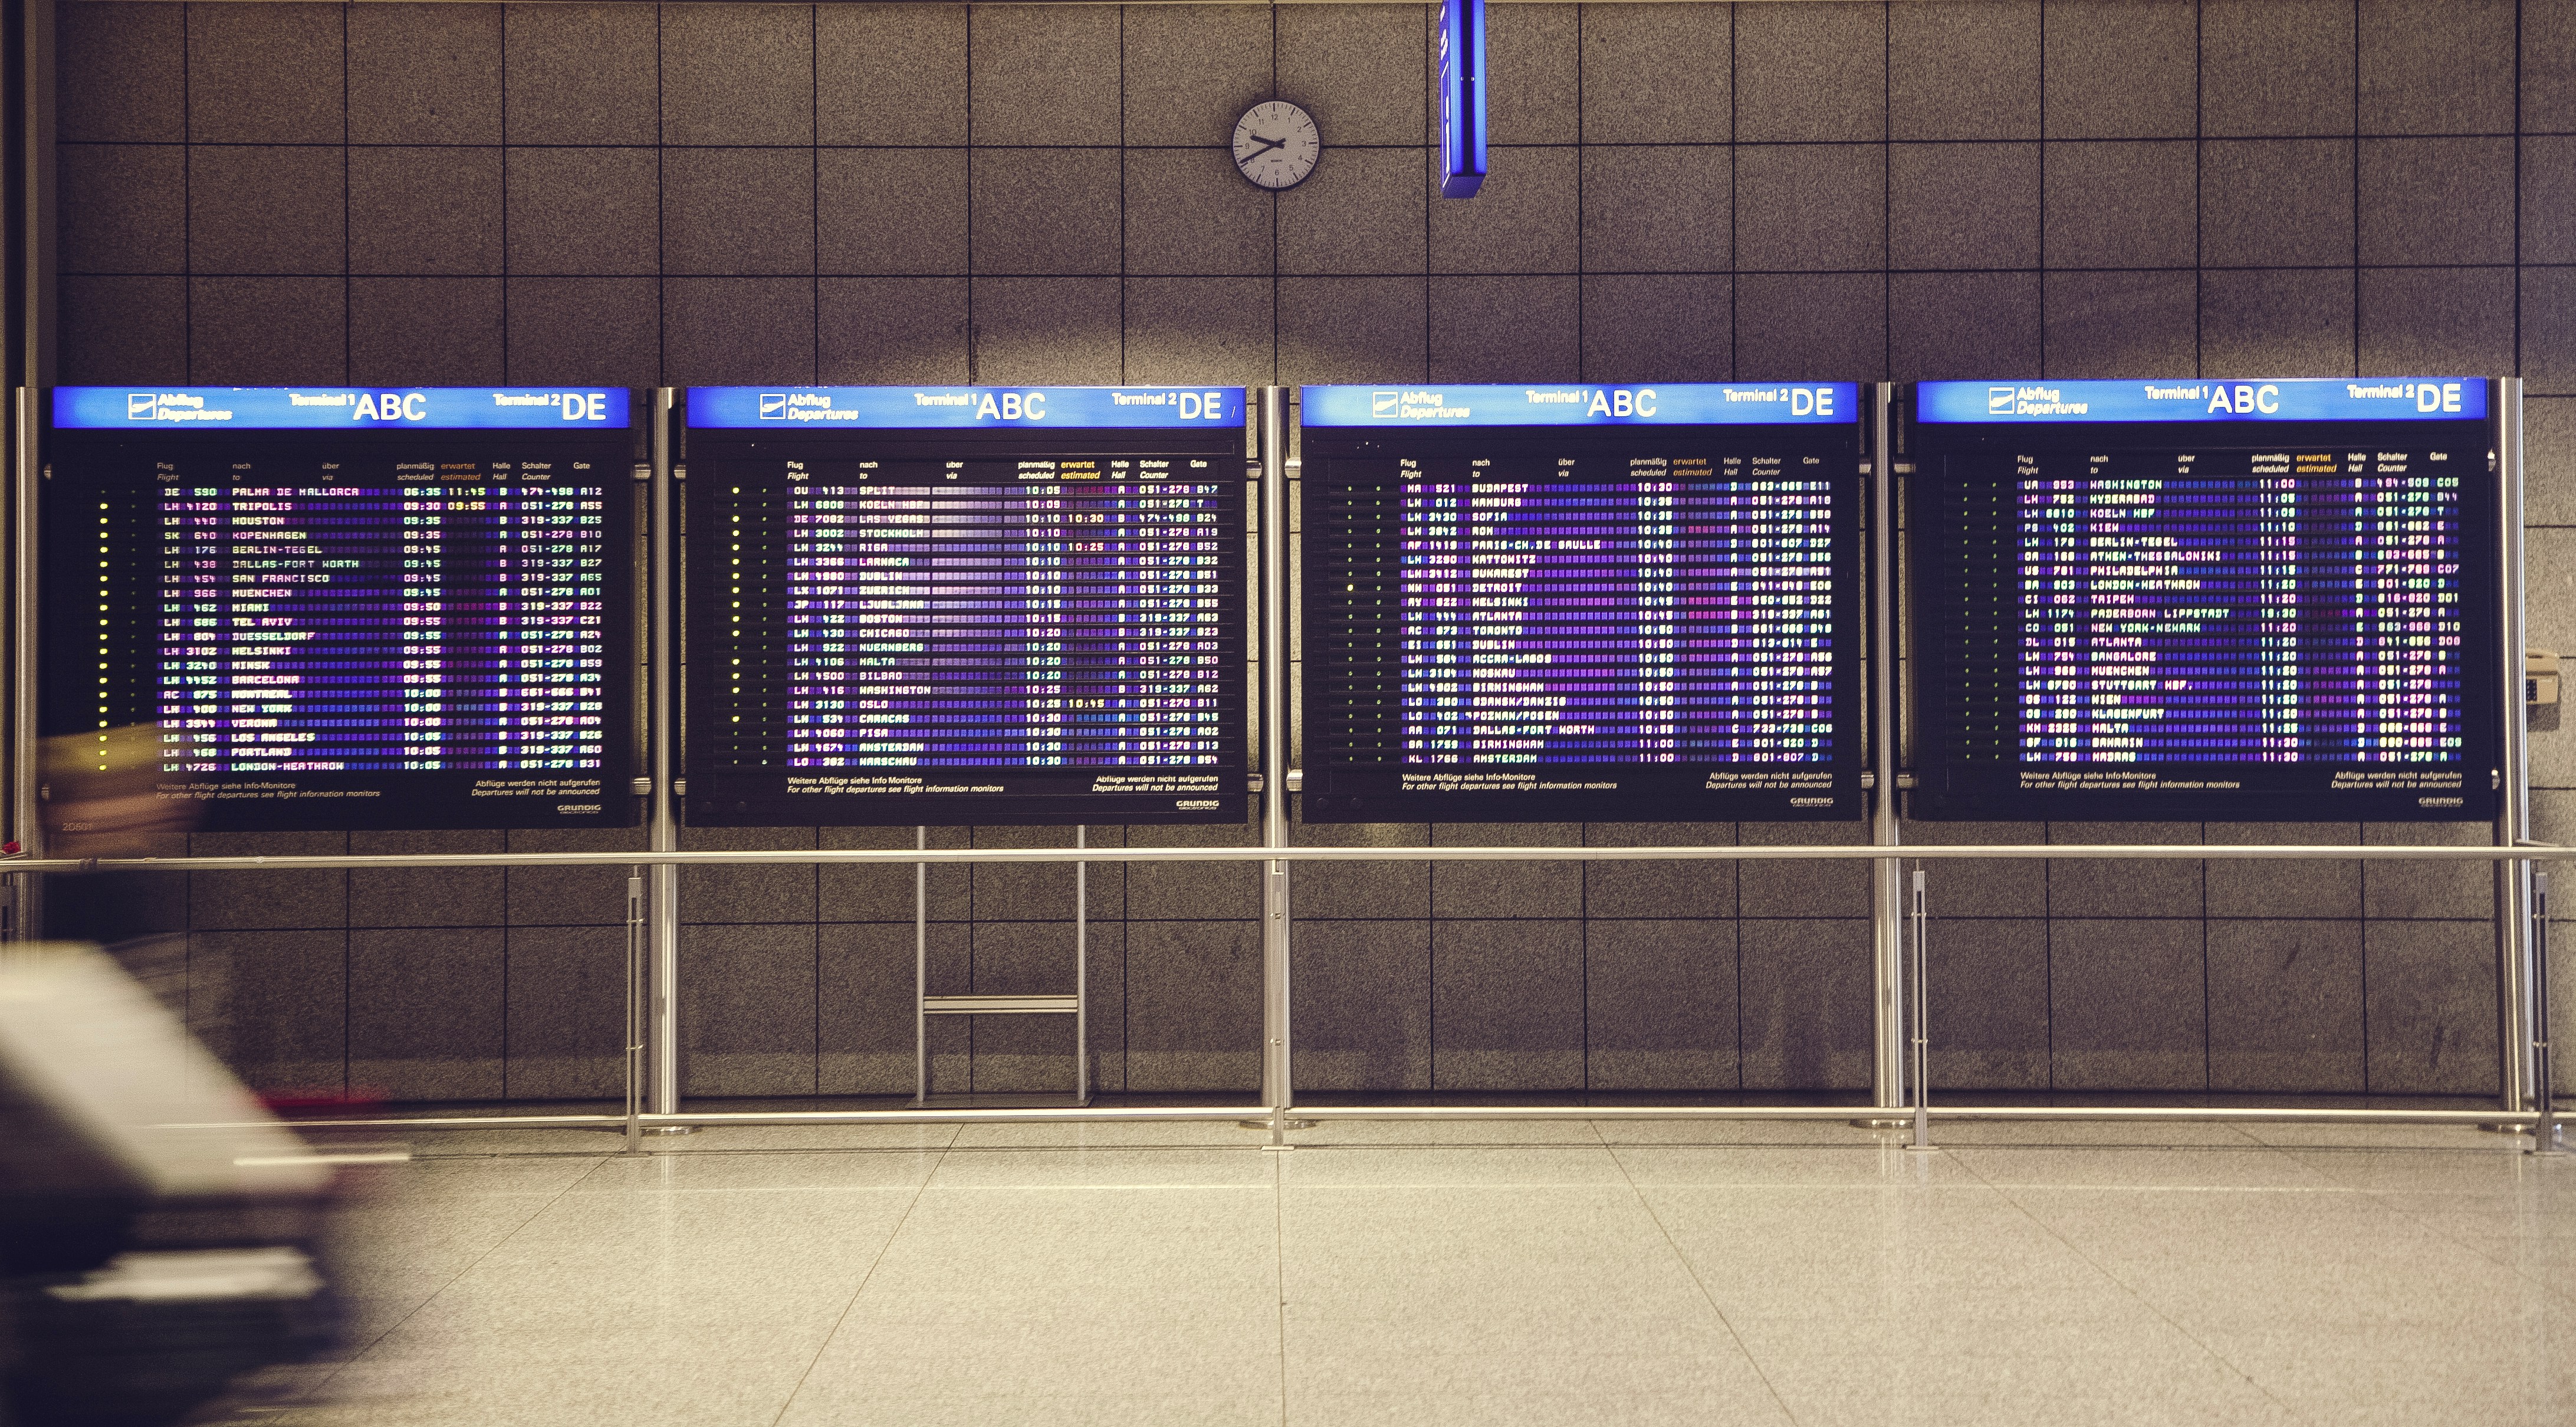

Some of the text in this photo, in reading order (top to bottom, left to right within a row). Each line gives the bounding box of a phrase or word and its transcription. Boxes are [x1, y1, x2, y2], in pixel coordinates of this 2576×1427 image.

[1401, 391, 1443, 406] Abflug
[2017, 386, 2060, 403] Abflug
[2145, 384, 2279, 414] Terminal 1 ABC
[2348, 383, 2461, 413] Terminal 2 DE
[158, 394, 203, 409] Abflug
[289, 393, 426, 420] Terminal 1 ABC
[493, 393, 606, 420] Terminal 2 DE
[788, 394, 830, 409] Abflug
[915, 392, 1046, 420] Terminal 1 ABC
[1112, 392, 1221, 419] Terminal 2 DE
[1526, 389, 1657, 417] Terminal 1 ABC
[1723, 388, 1833, 416] Terminal 2 DE
[157, 408, 232, 422] Departures
[1401, 406, 1470, 420] Departures
[2017, 403, 2088, 417] Departures
[788, 409, 859, 422] Departures
[157, 462, 173, 471] Flug
[787, 461, 803, 469] Flug
[157, 474, 179, 482] Flight
[788, 472, 809, 481] Flight
[1473, 484, 1528, 492] BUDAPEST
[2091, 480, 2161, 489] WASHINGTON
[405, 488, 441, 496] 06:35
[860, 486, 895, 495] SPLIT
[1026, 486, 1060, 495] 10:05
[1197, 485, 1217, 494] B47
[448, 502, 485, 510] 09:55
[1473, 612, 1522, 620] ATLANTA
[2092, 637, 2141, 647] ATLANTA
[1473, 740, 1543, 748] BIRMINGHAM
[1474, 754, 1536, 762] AMSTERDAM
[1433, 774, 1462, 782] Abflüge
[1486, 773, 1535, 783] Info-Monitore
[475, 780, 505, 788] Abflüge
[560, 779, 600, 787] aufgerufen
[1439, 781, 1458, 791] flight
[1460, 782, 1500, 791] departures
[1518, 782, 1537, 791] flight
[471, 787, 514, 797] Departures
